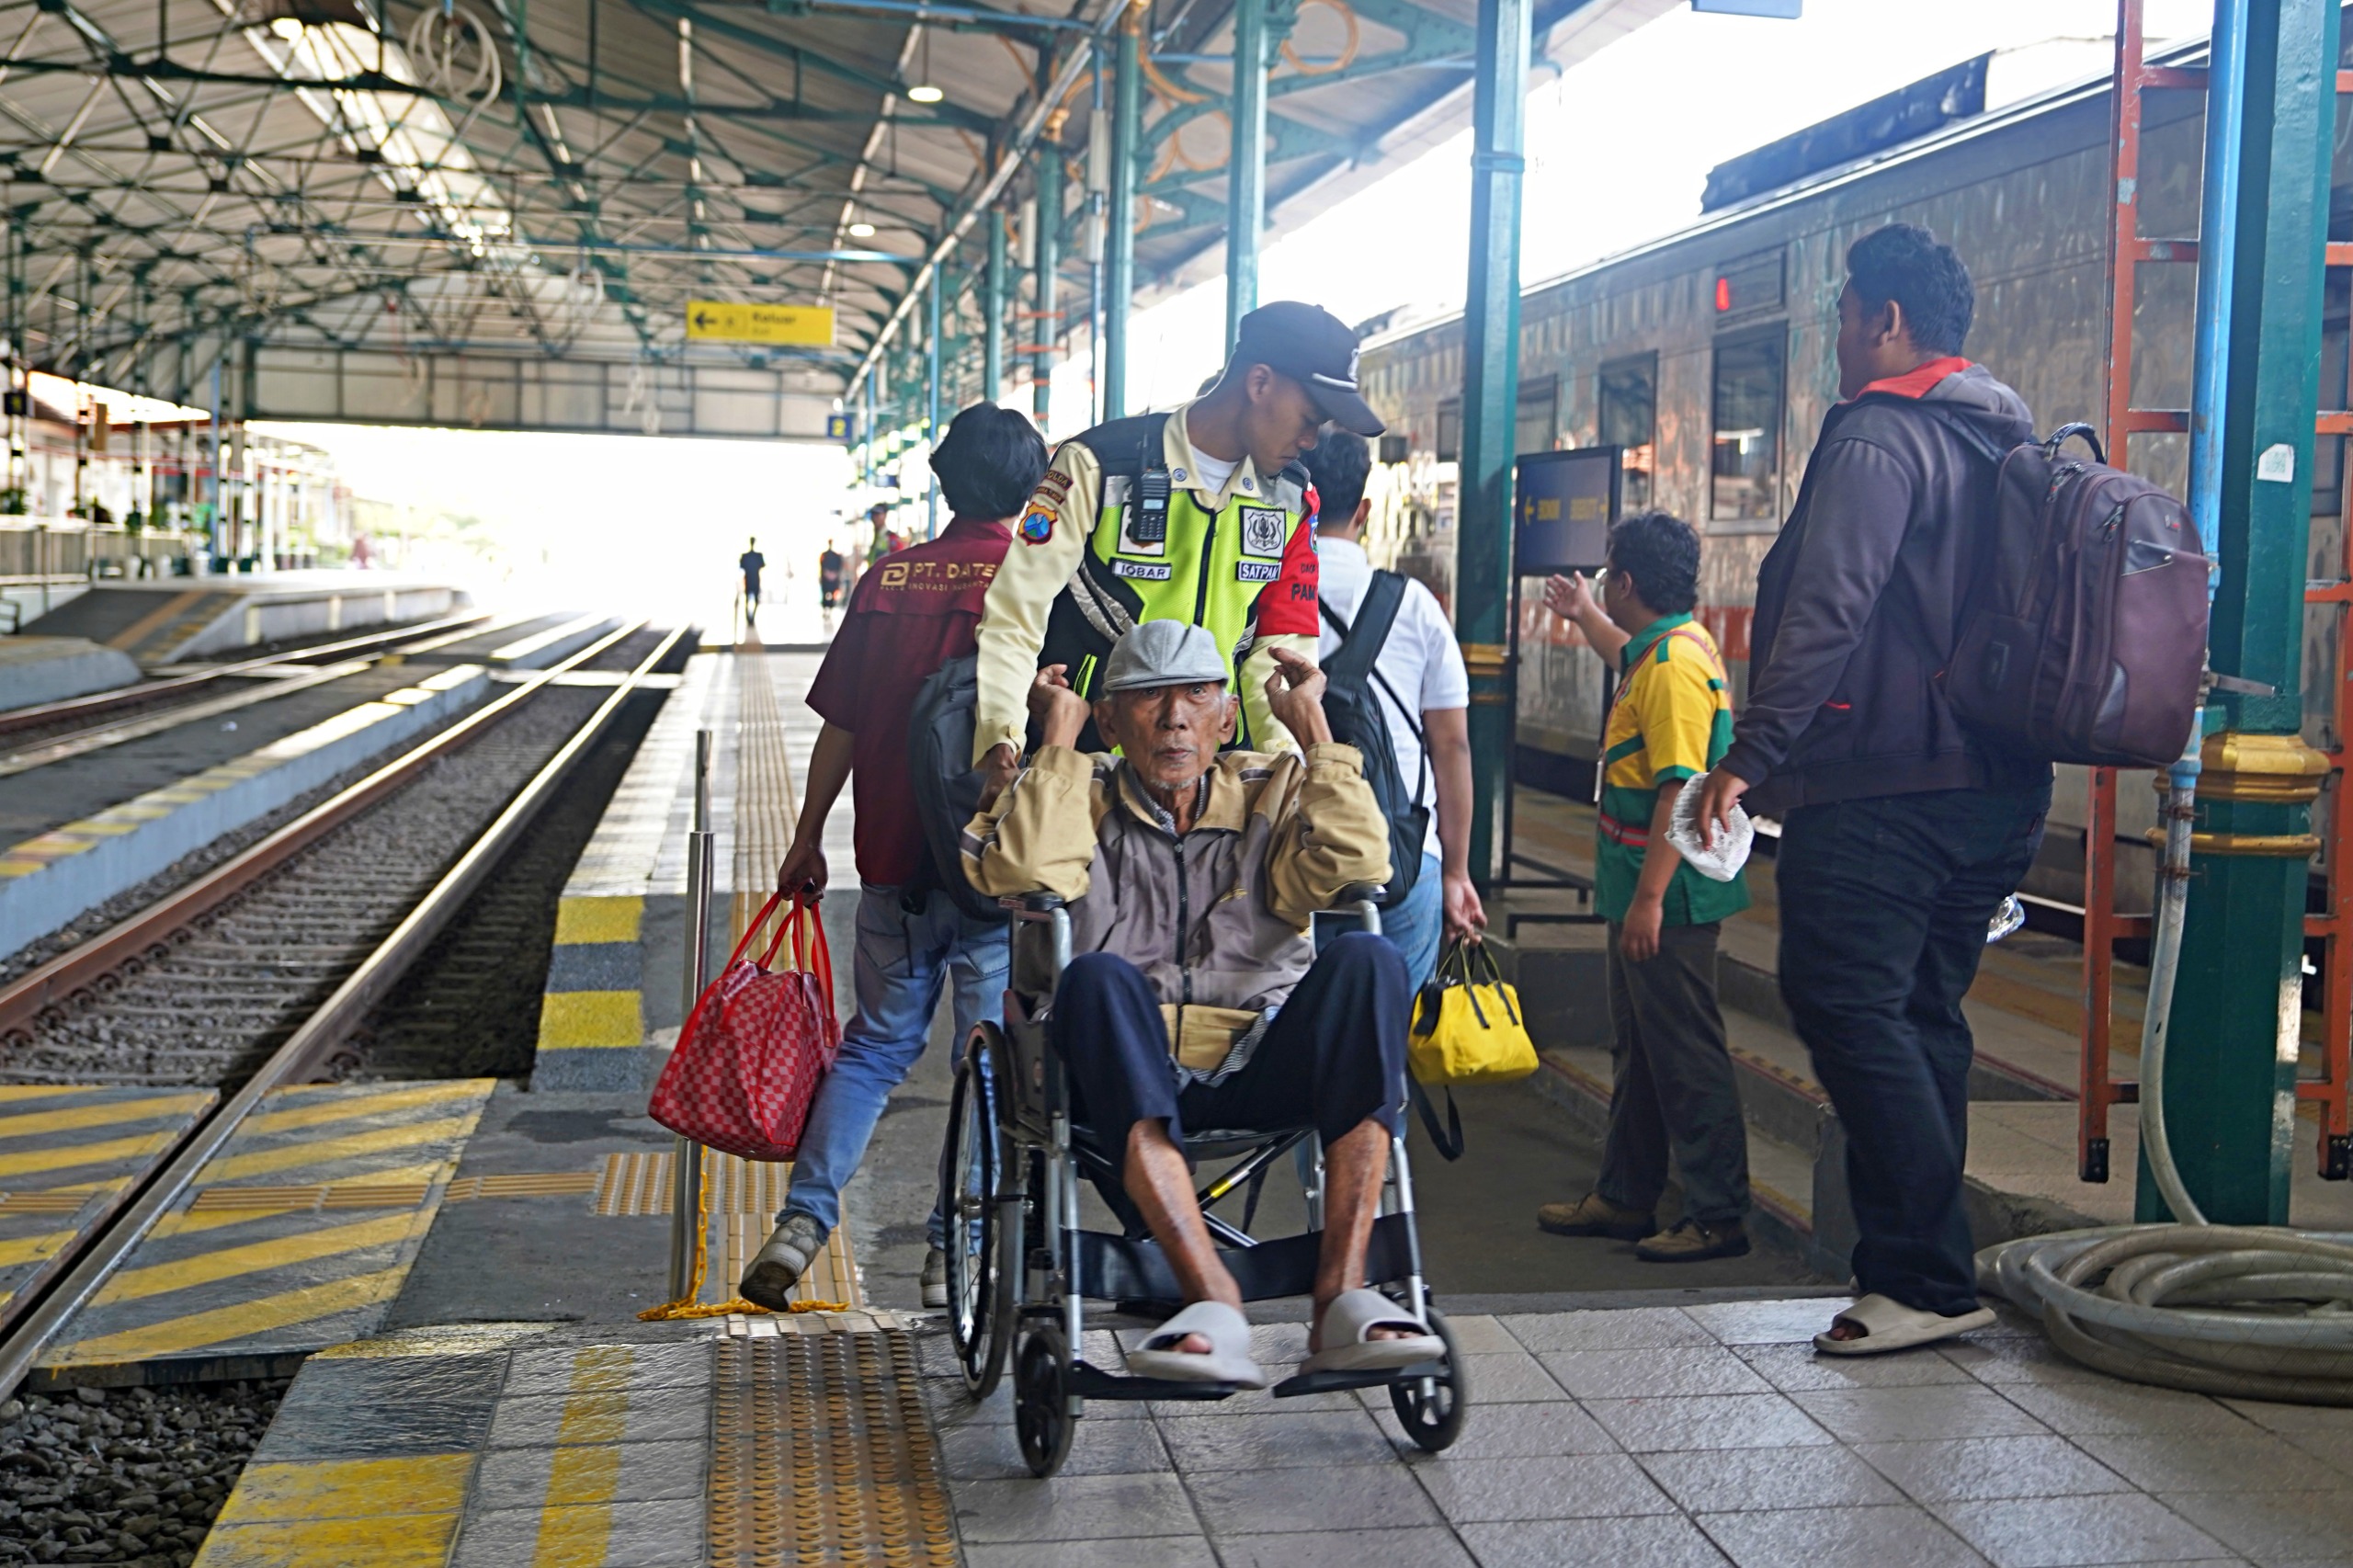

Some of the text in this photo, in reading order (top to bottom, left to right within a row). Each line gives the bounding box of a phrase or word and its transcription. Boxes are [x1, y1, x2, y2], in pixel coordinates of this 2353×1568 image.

[832, 418, 847, 436] 2
[913, 562, 940, 577] PT.
[908, 582, 948, 592] INOVASI
